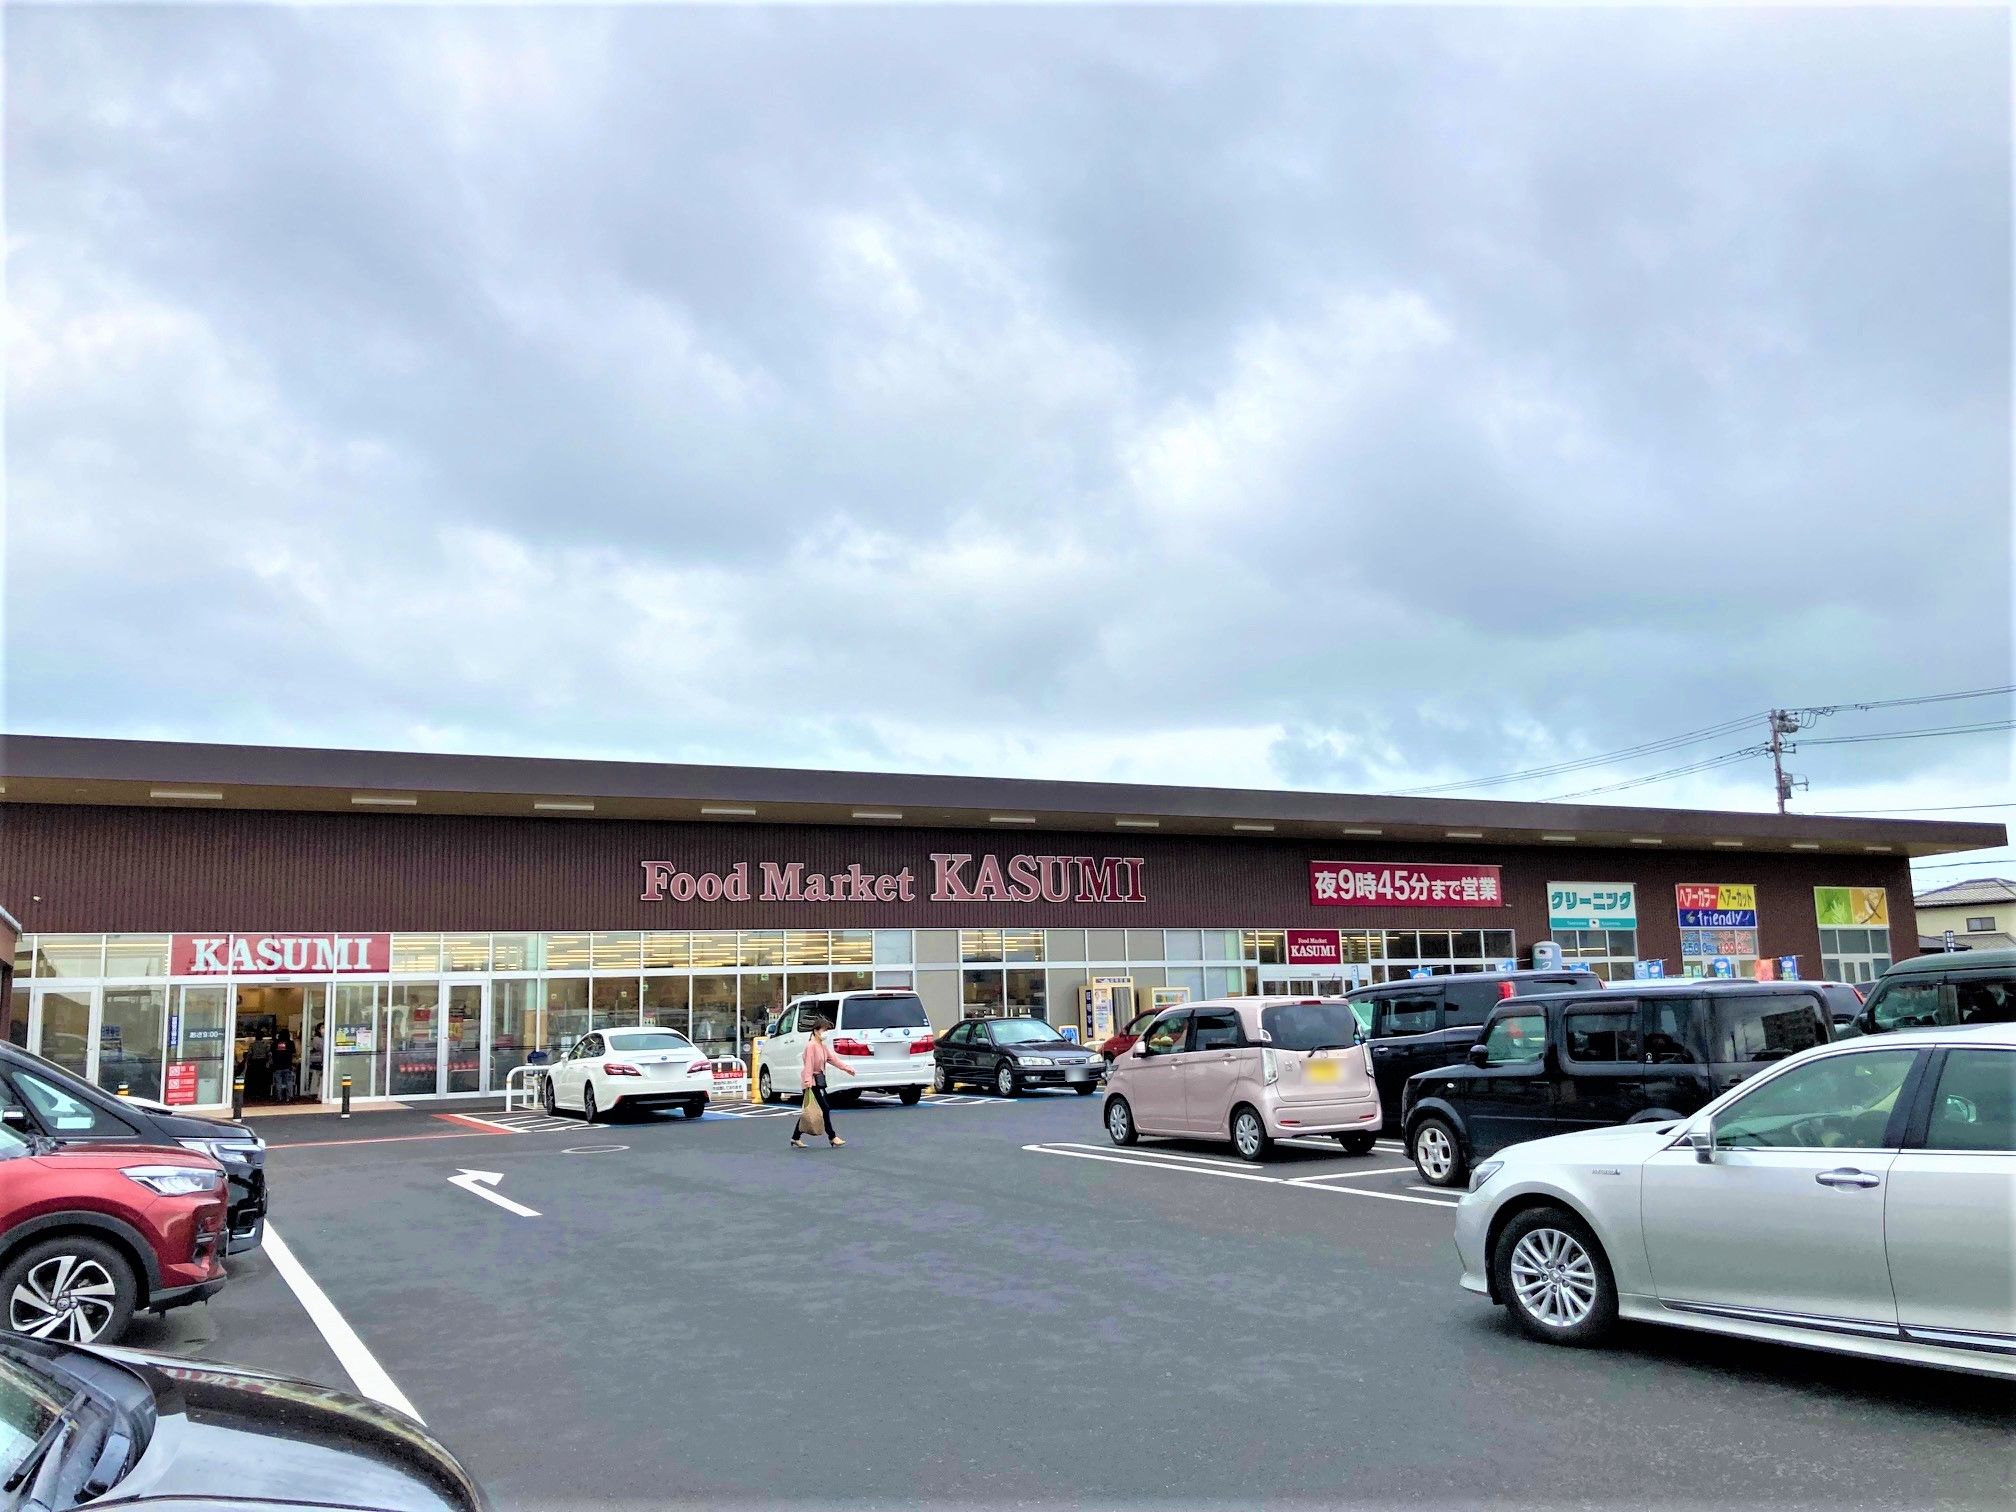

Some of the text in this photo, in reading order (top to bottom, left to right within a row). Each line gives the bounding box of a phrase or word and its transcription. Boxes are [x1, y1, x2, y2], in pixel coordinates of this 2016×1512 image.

[640, 853, 1147, 903] Food Market KASUMI
[1314, 868, 1498, 901] 夜9時45分まで営業
[1551, 891, 1632, 911] クリーニング
[1679, 887, 1717, 908] ヘアーカラー
[1697, 910, 1743, 926] friendly
[190, 938, 373, 972] KASUMI
[1290, 945, 1336, 957] KASUMI
